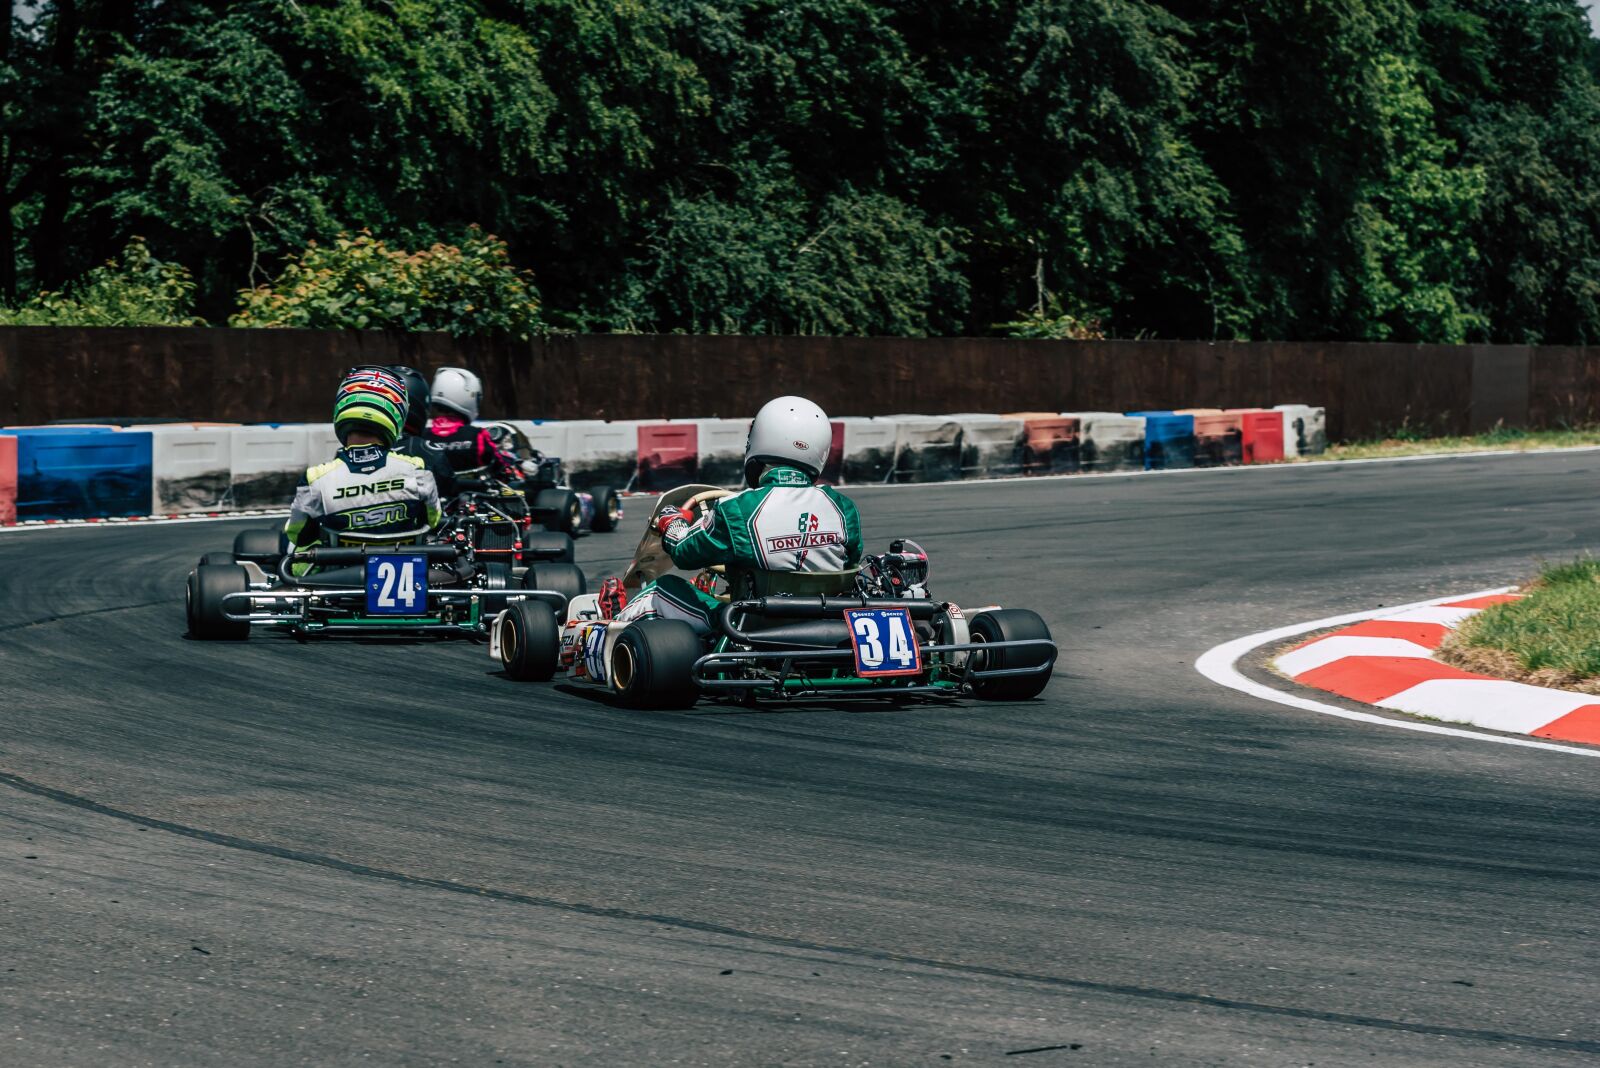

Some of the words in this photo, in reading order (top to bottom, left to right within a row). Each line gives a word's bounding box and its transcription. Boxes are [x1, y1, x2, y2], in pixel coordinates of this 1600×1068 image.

[795, 441, 808, 449] BELL
[333, 479, 405, 500] JONES
[768, 537, 801, 550] TONY
[378, 562, 415, 607] 24
[854, 617, 913, 667] 34
